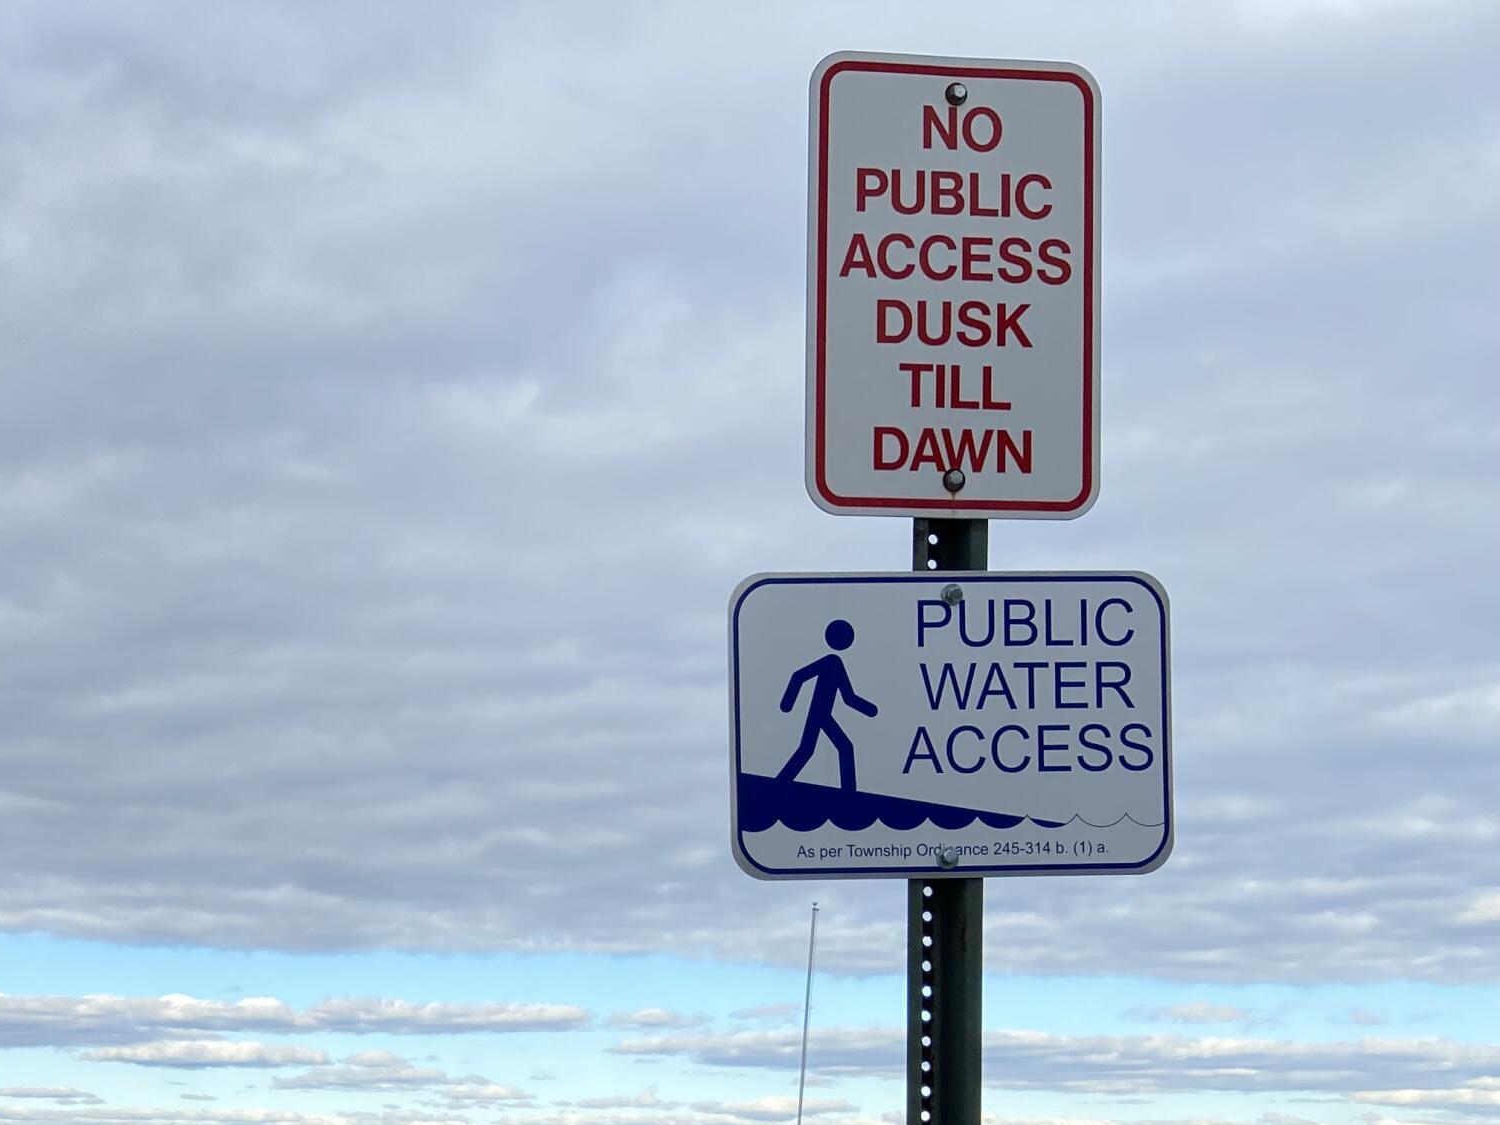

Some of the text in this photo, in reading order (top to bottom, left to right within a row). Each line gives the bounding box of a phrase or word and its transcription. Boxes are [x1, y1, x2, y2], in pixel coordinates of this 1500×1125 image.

[922, 105, 1003, 152] NO
[855, 168, 1053, 220] PUBLIC
[839, 233, 1072, 285] ACCESS
[876, 299, 1034, 348] DUSK
[899, 363, 1012, 410] TILL
[872, 426, 1032, 474] DAWN
[917, 598, 1135, 648] PUBLIC
[919, 661, 1135, 711] WATER
[902, 723, 1154, 775] ACCESS
[797, 840, 1109, 860] As per Township Ordance 245-314 b. (1) a.
